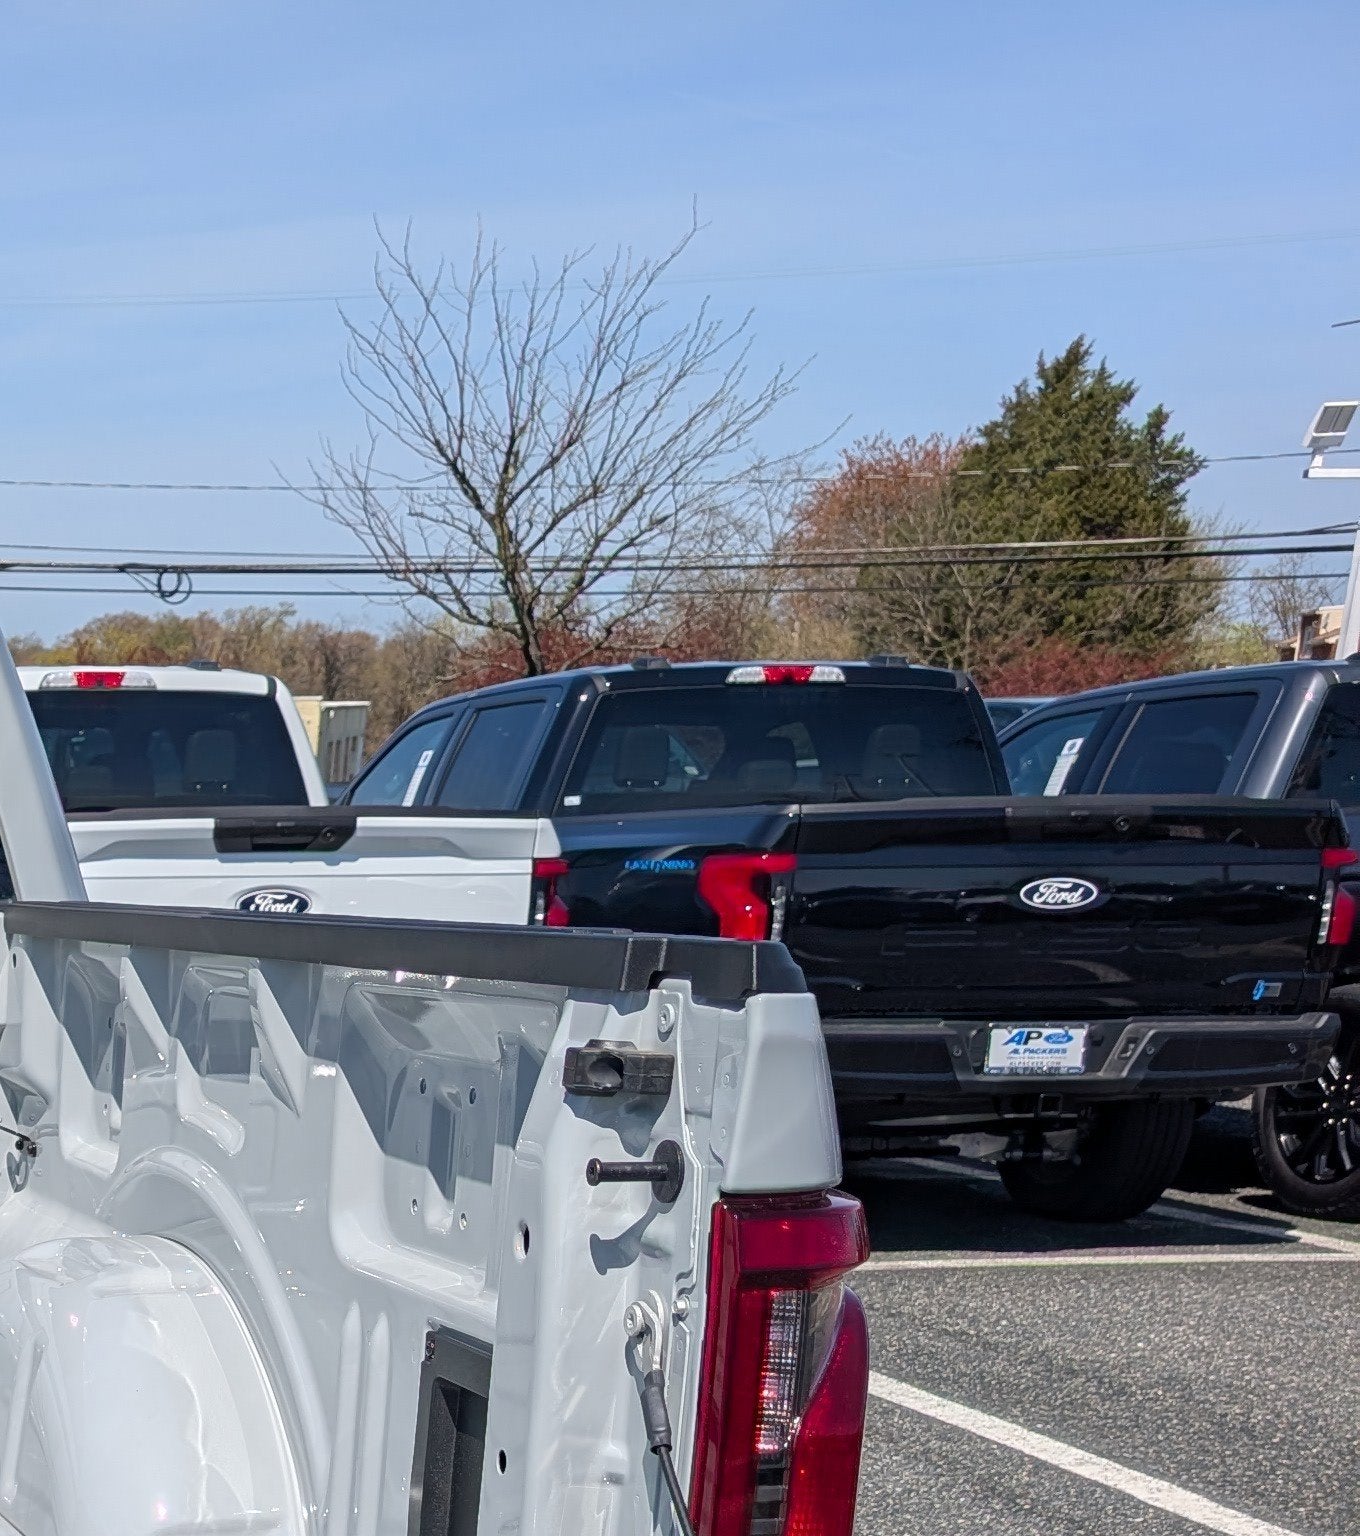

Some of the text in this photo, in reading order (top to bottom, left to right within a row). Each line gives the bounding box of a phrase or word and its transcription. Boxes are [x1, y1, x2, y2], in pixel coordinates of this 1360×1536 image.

[1032, 881, 1086, 904] Ford
[248, 893, 300, 913] Ford
[1001, 1030, 1043, 1046] AP
